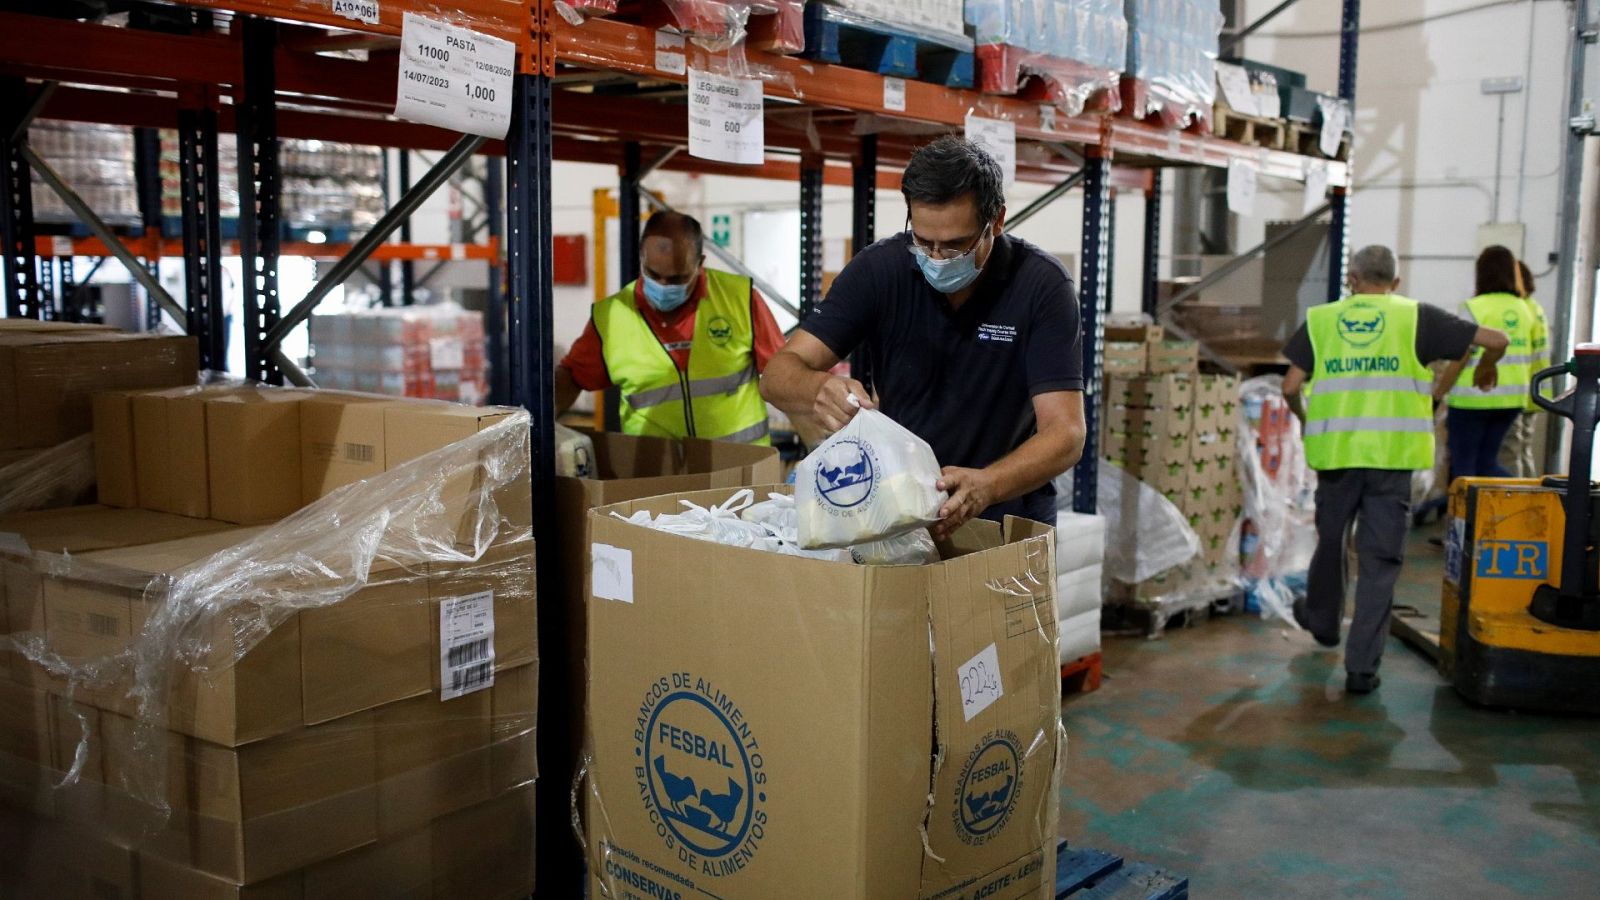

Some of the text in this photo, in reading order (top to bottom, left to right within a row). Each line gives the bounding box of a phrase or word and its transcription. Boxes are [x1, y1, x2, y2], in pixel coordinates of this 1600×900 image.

[446, 36, 477, 53] PASTA
[418, 44, 512, 77] 11000 12/08/2020
[403, 70, 449, 89] 14/07/2023
[465, 83, 495, 102] 1,000
[724, 121, 740, 133] 600
[1324, 356, 1400, 374] VOLUNTARIO
[1482, 542, 1543, 577] TR
[634, 672, 768, 785] BANCOS DE ALIMENTOS
[982, 732, 993, 746] DE
[659, 722, 735, 769] FESBAL
[971, 758, 1011, 785] FESBAL
[635, 765, 768, 878] BANCOS DE ALIMENTOS
[641, 858, 696, 889] recomendada
[973, 873, 1011, 900] ACEITE
